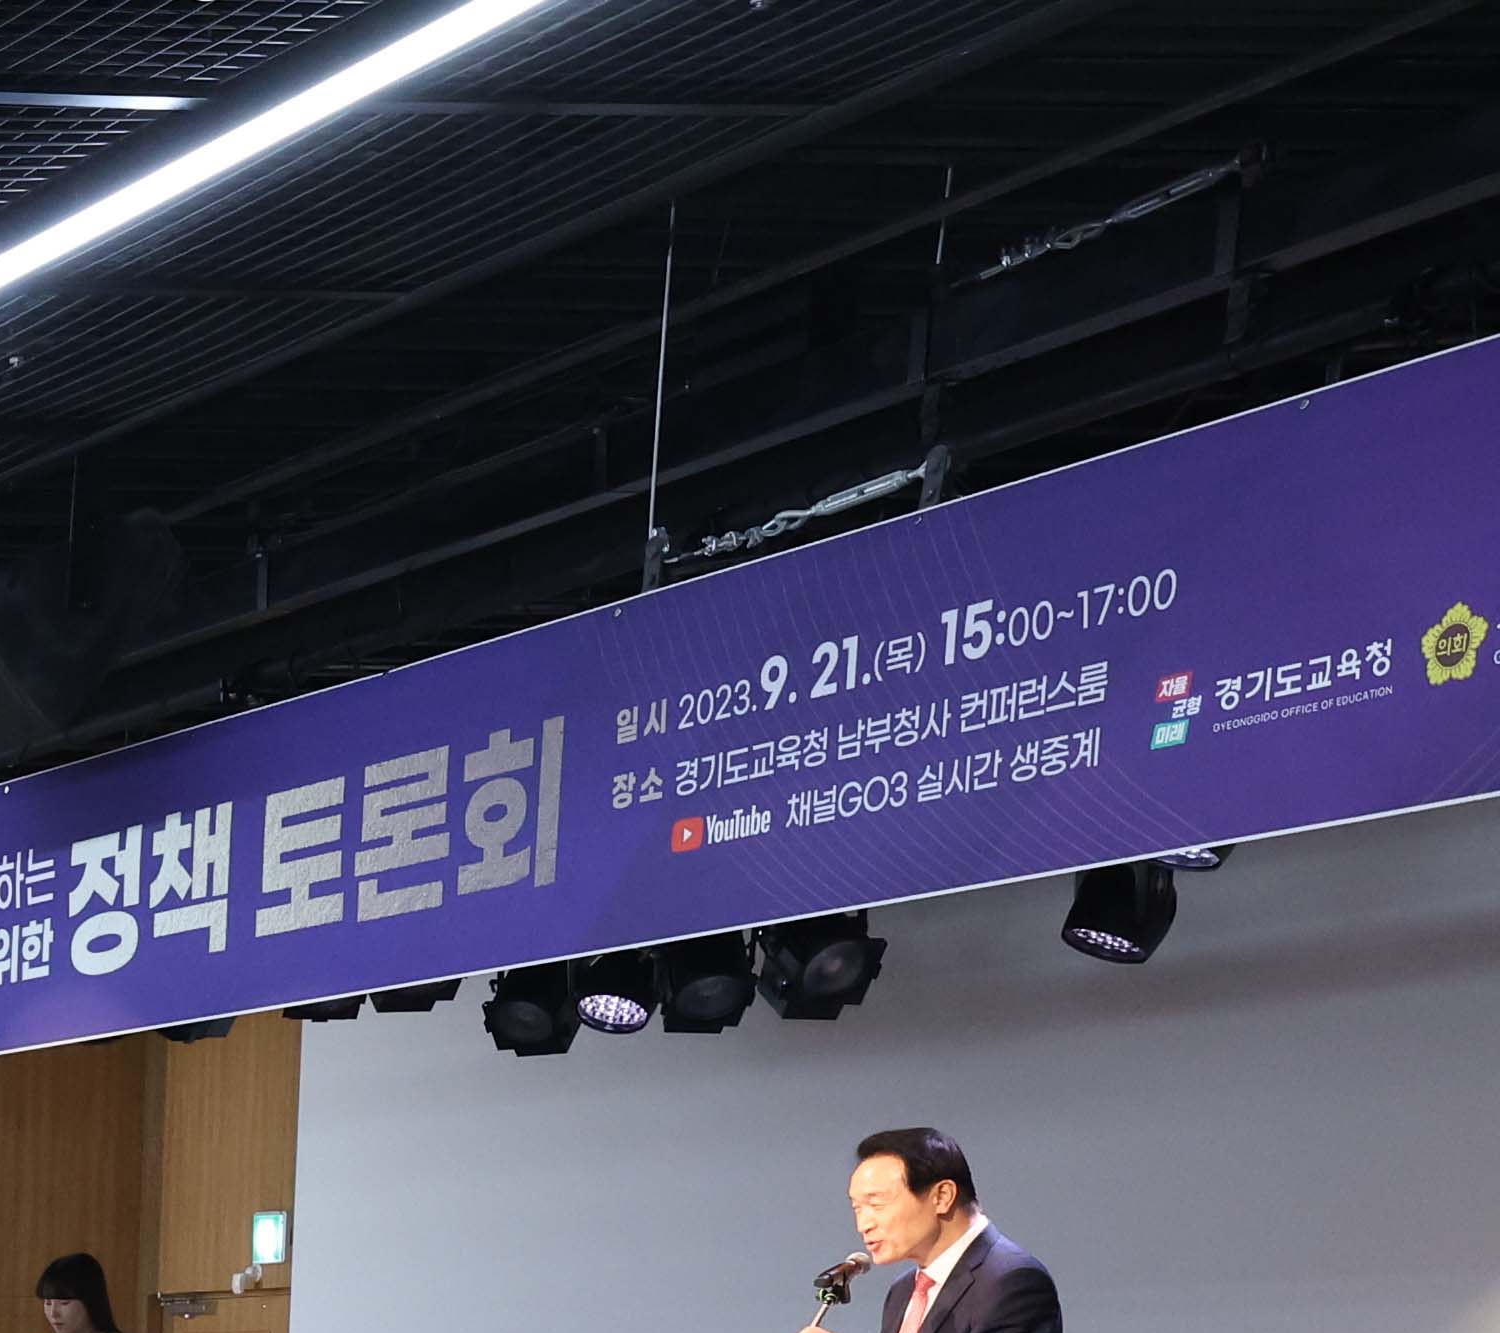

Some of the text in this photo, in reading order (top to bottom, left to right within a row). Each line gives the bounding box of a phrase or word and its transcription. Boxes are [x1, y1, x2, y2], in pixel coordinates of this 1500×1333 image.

[941, 569, 1177, 665] 15:00~17:00
[1437, 633, 1467, 656] 의회
[1172, 695, 1202, 718] 균형
[1215, 638, 1392, 710] 경기도교육청
[1281, 702, 1318, 718] OFFICE
[1321, 698, 1334, 710] OF
[1336, 686, 1393, 706] EDUCATION
[676, 727, 827, 796] 경기도교육청
[838, 698, 950, 760] 남부청사
[960, 661, 1108, 733] 컨퍼런스룸
[1155, 721, 1185, 744] 미래
[706, 727, 1100, 845] YouTube 채널GO3 실시간 생중계
[69, 715, 565, 976] 정책 토론회
